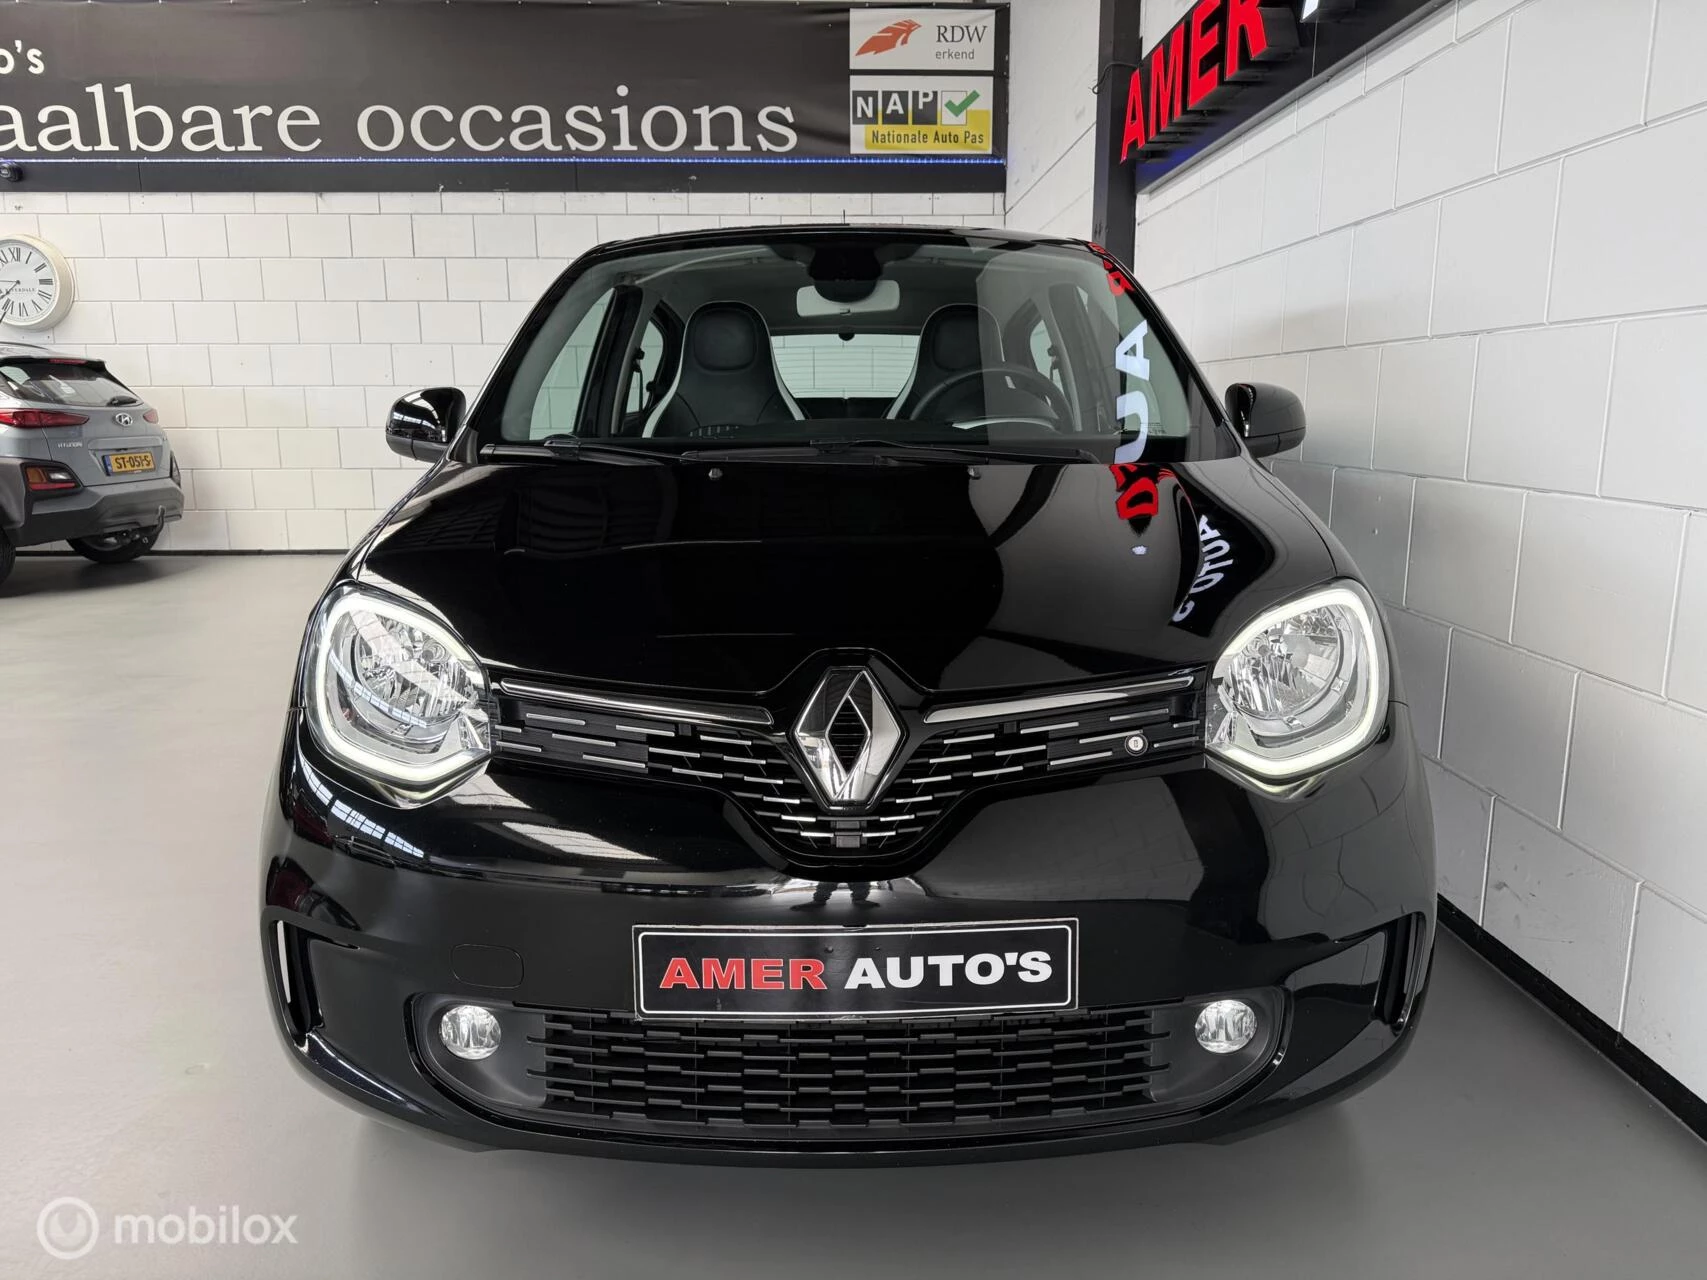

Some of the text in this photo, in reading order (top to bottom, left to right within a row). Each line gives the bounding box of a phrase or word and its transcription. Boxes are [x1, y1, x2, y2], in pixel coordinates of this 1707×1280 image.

[936, 25, 987, 43] RDW
[935, 49, 975, 60] erkend
[1119, 0, 1267, 164] AMER
[0, 82, 798, 152] aalbare occasions
[856, 91, 933, 118] NAP
[872, 130, 984, 144] Nationale Auto Pas
[660, 951, 1053, 990] AMER AUTO'S
